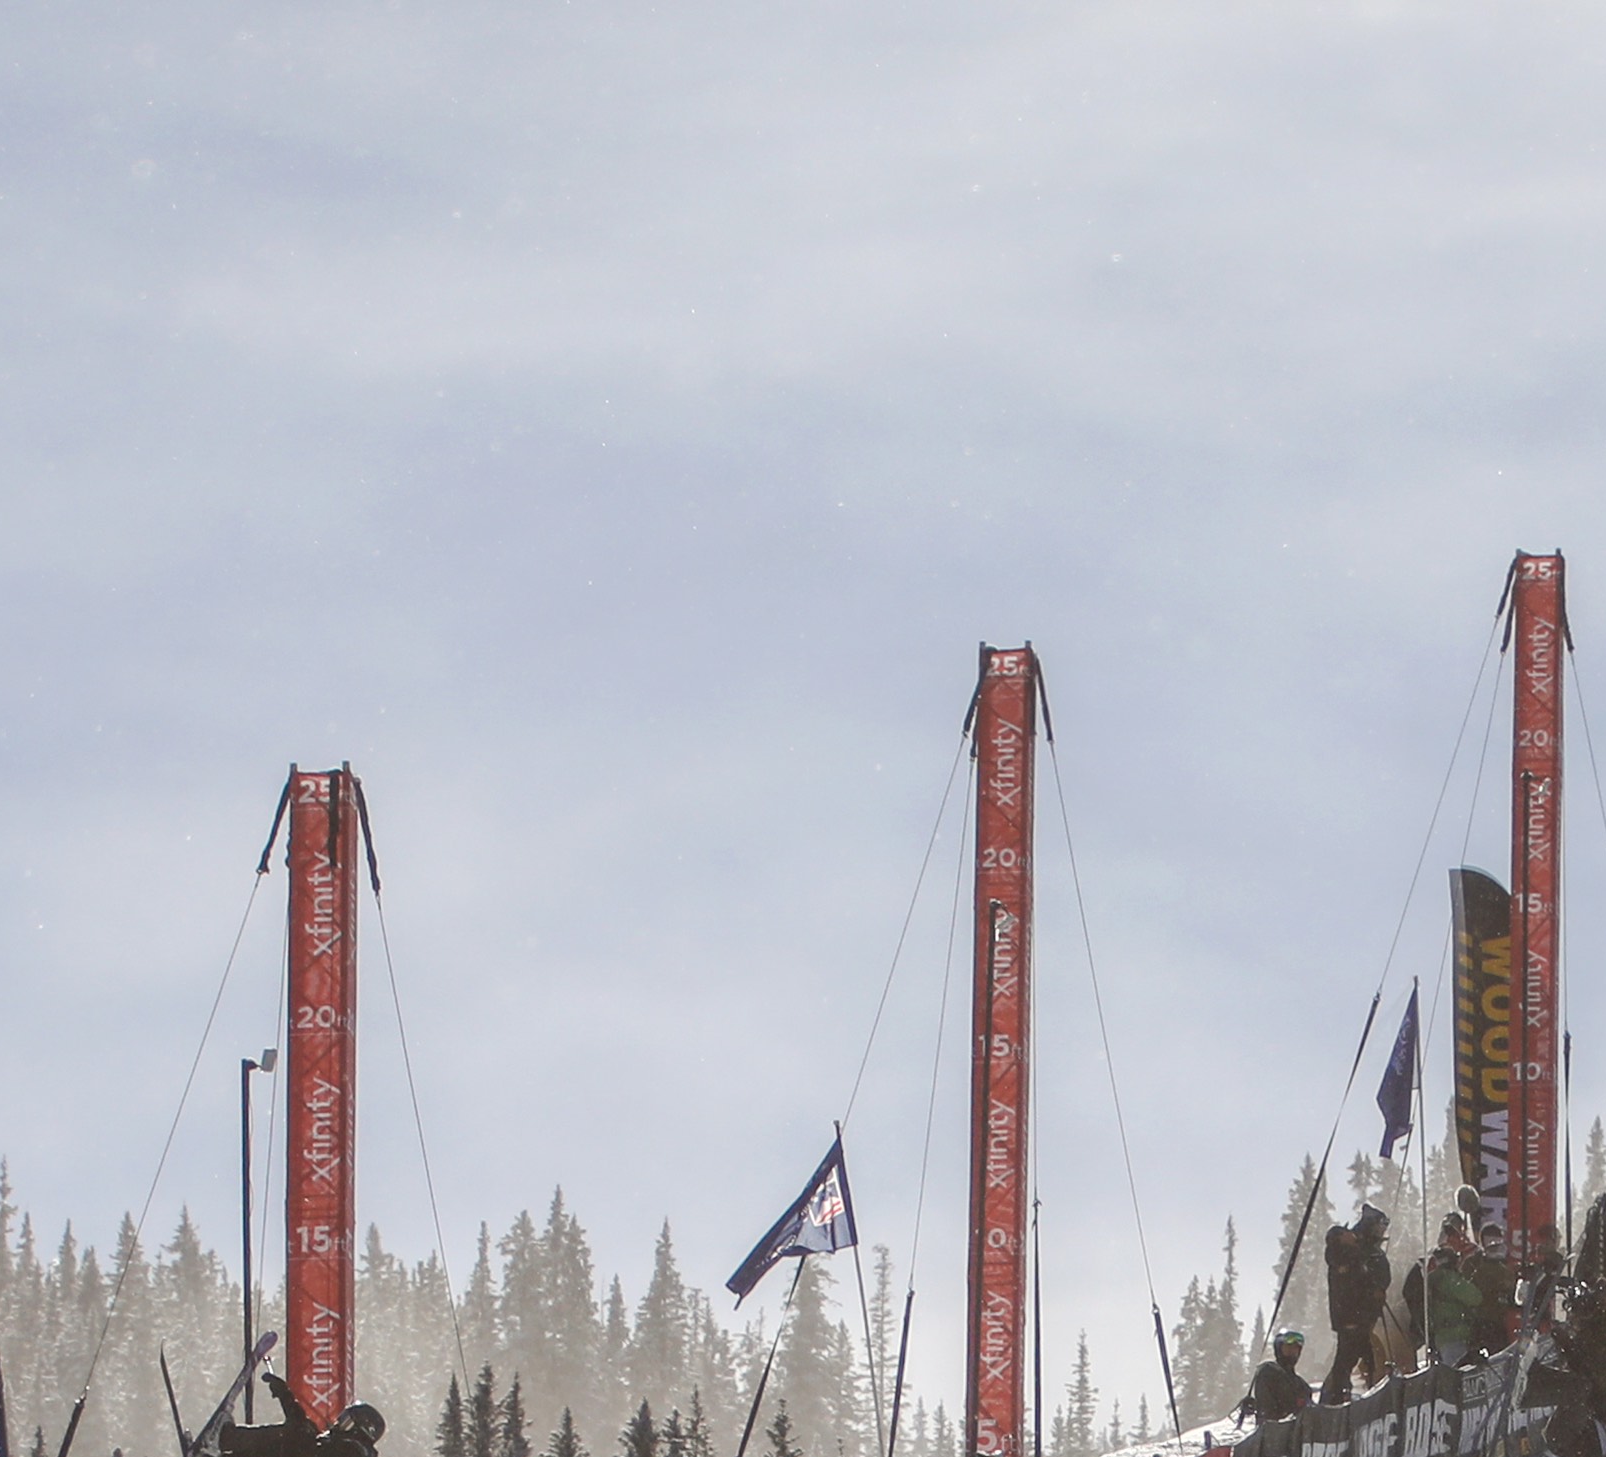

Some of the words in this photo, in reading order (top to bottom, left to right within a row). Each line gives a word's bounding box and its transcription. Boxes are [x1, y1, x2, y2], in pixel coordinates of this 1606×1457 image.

[1522, 561, 1552, 580] 25
[986, 655, 1019, 677] 25
[1526, 615, 1555, 695] xfinity
[1519, 729, 1549, 748] 20
[992, 718, 1023, 808] xfinity
[299, 779, 331, 805] 25
[982, 848, 1016, 868] 20
[304, 850, 342, 956] xfinity
[1515, 892, 1543, 914] 15
[296, 1005, 336, 1029] 20
[978, 1033, 1011, 1059] 15
[1512, 1061, 1543, 1082] 10
[302, 1076, 342, 1183] xfinity
[988, 1098, 1016, 1190] xfinity
[295, 1225, 331, 1254] 15
[980, 1286, 1012, 1382] xfinity
[302, 1301, 341, 1407] xfinity
[976, 1418, 997, 1453] 5
